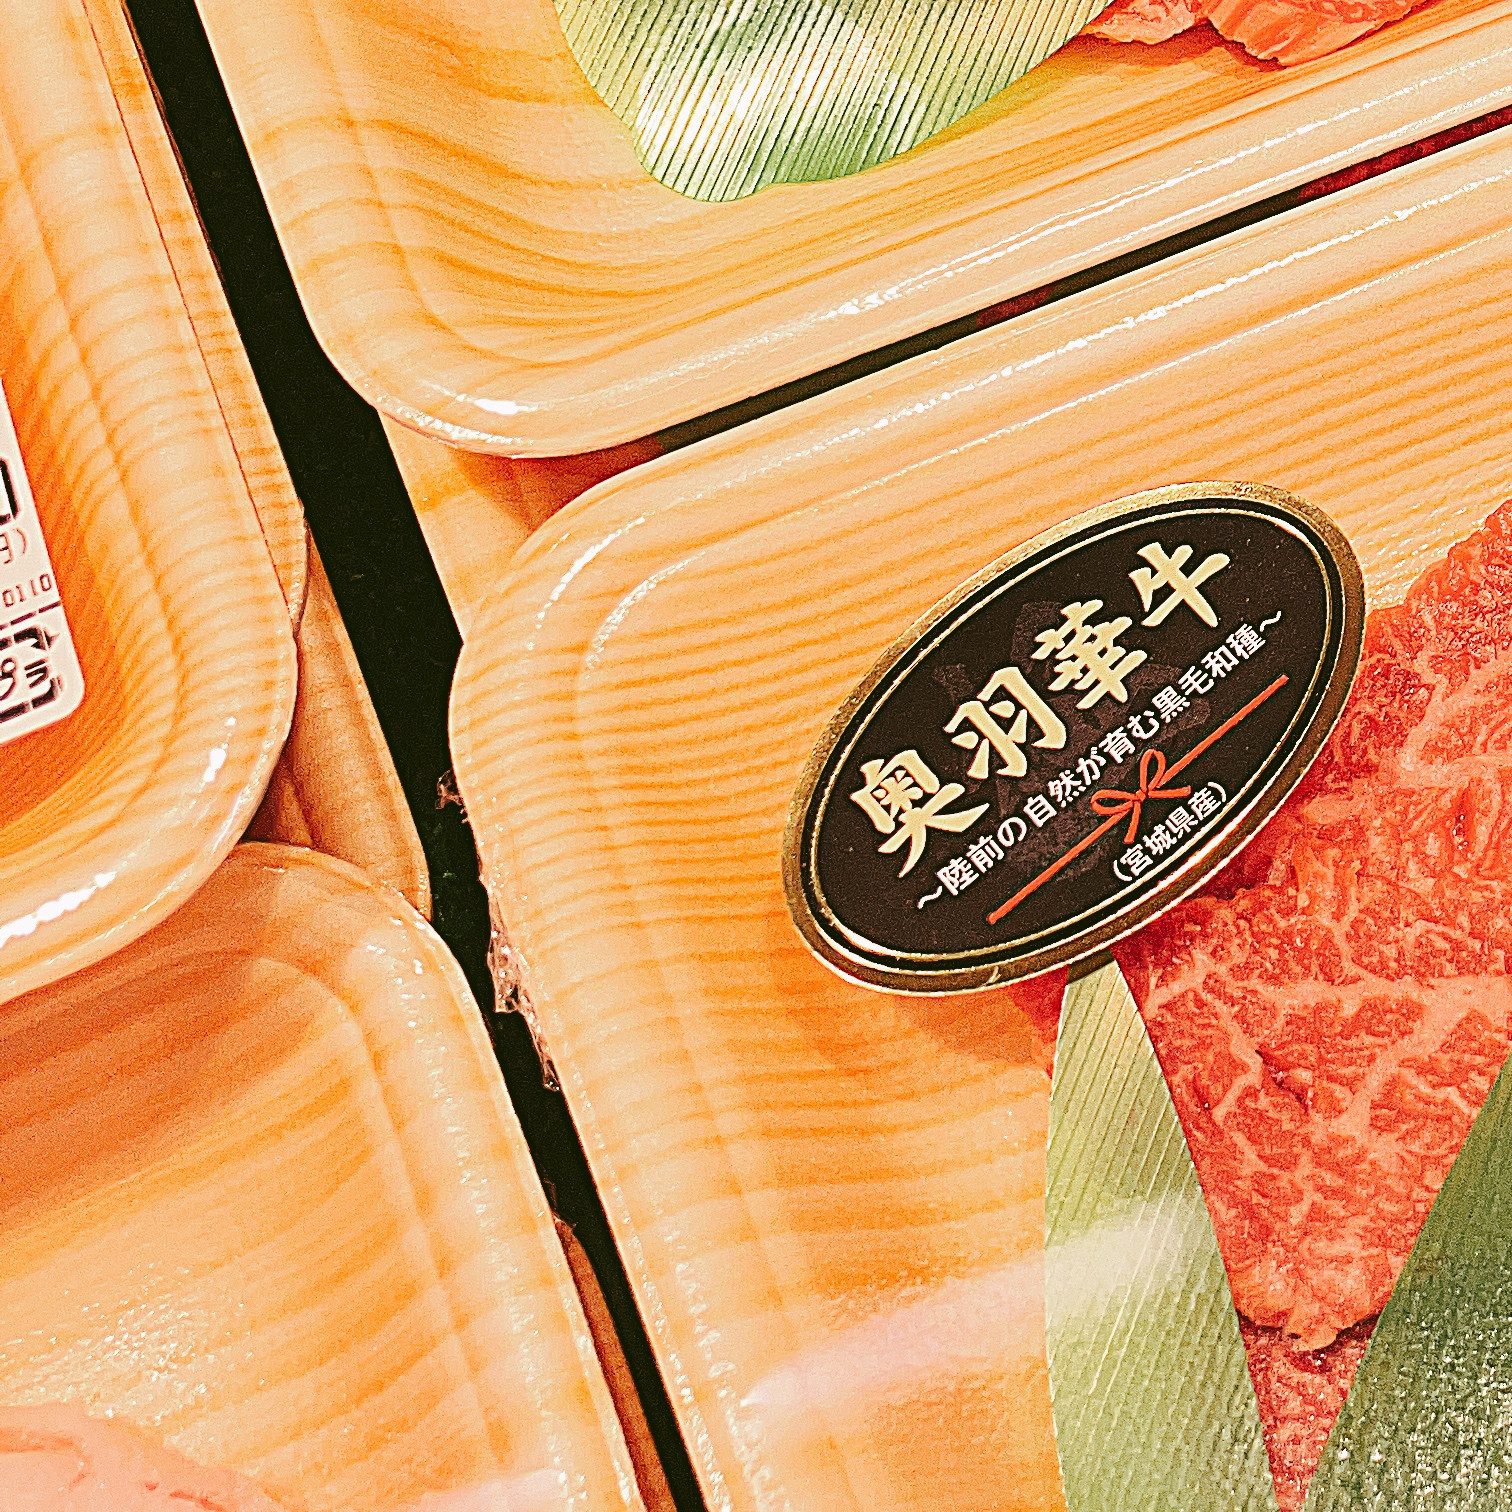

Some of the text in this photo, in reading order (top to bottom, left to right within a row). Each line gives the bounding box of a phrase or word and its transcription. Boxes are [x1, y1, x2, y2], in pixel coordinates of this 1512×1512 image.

[848, 541, 1231, 879] 奥羽華牛
[1112, 780, 1229, 883] (宮城県産)
